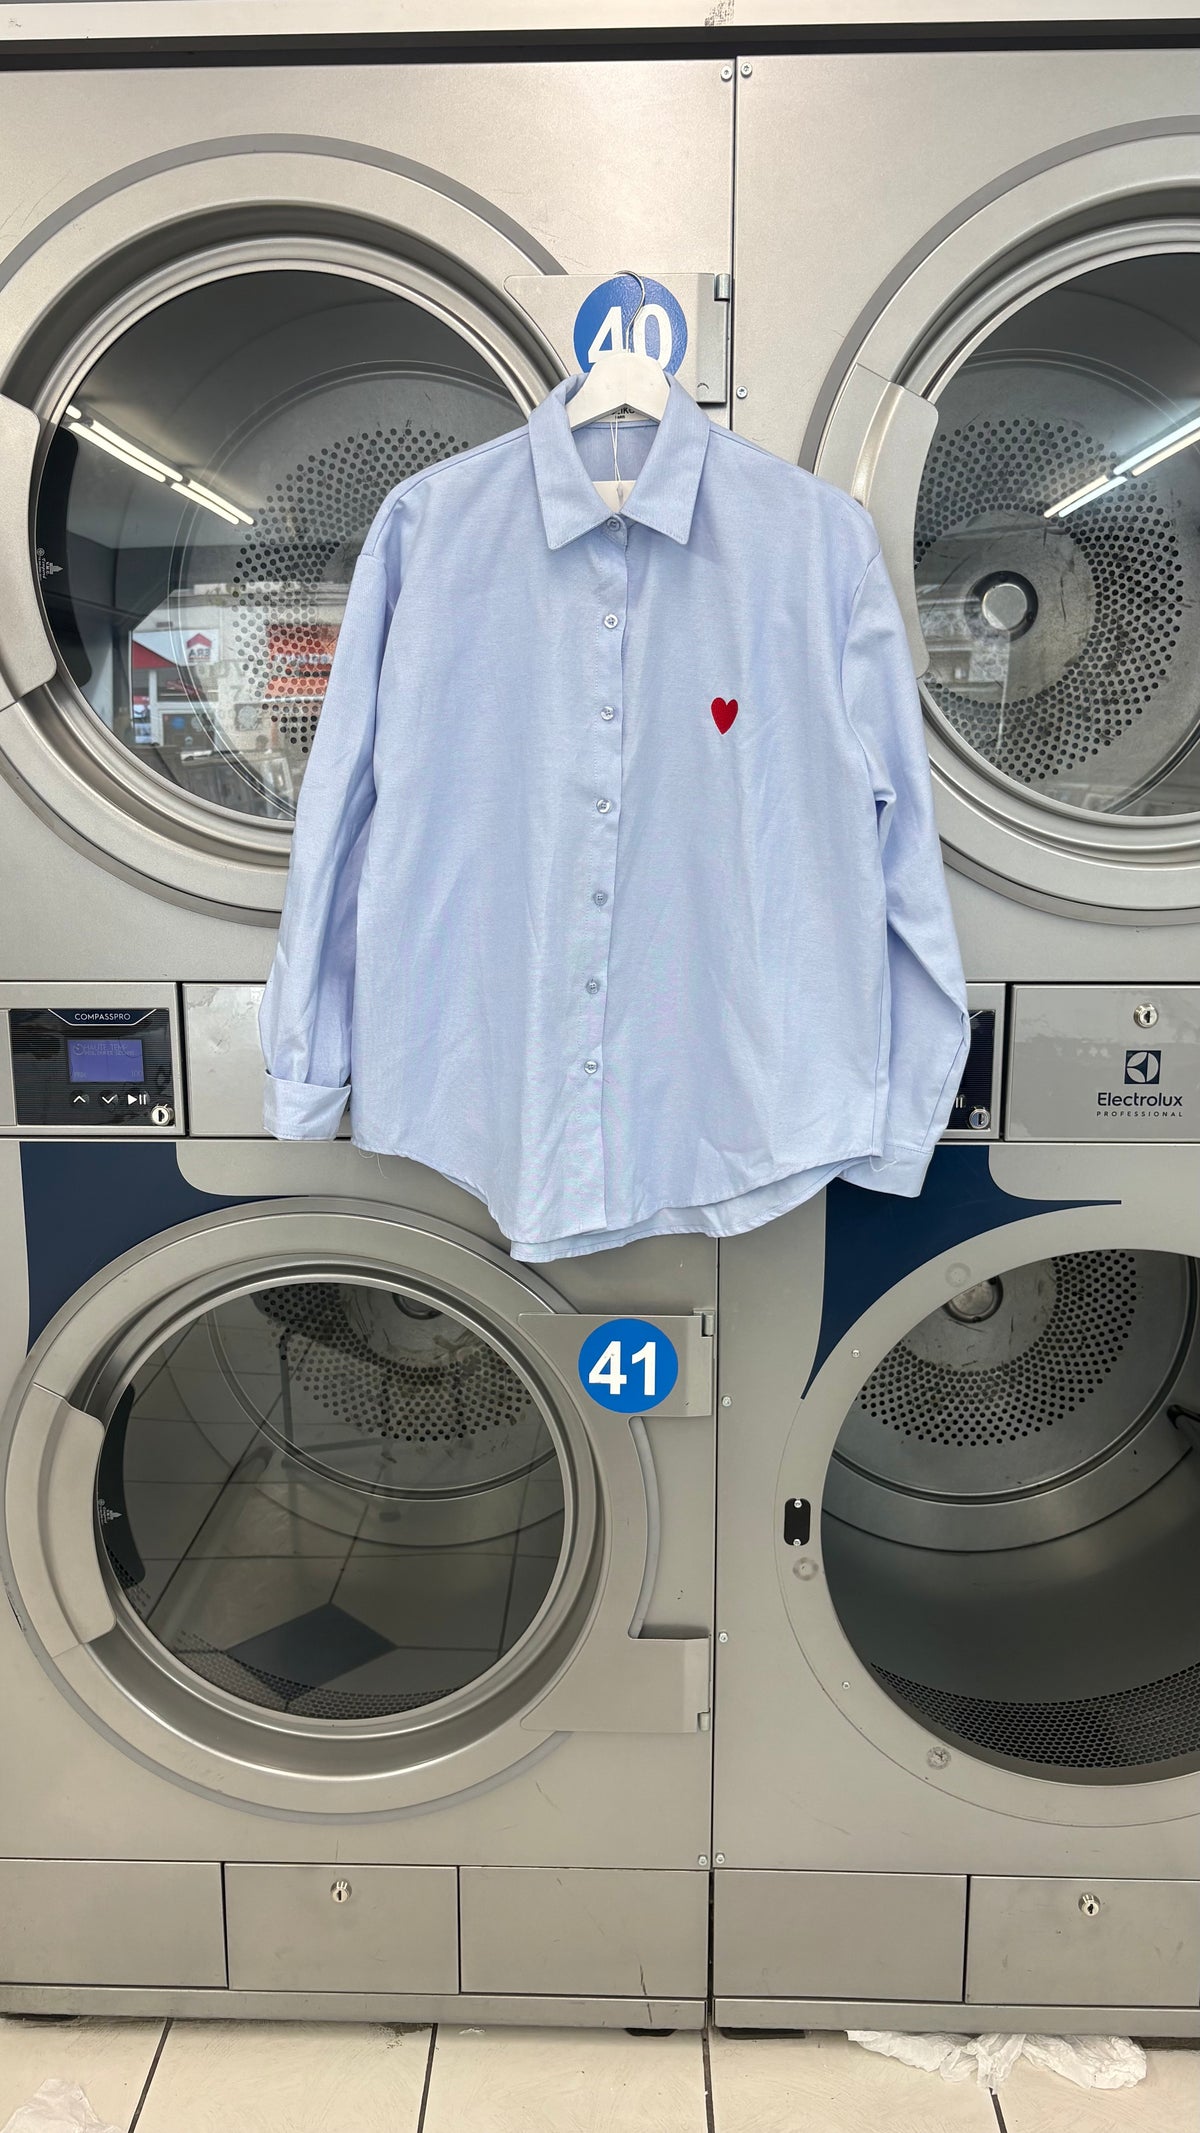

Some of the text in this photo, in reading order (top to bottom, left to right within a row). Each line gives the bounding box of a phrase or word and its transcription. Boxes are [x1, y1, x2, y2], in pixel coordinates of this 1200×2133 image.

[588, 304, 673, 370] 40
[74, 1013, 131, 1021] COMPASSPRO
[1097, 1092, 1183, 1107] Electrolux
[588, 1340, 656, 1396] 41
